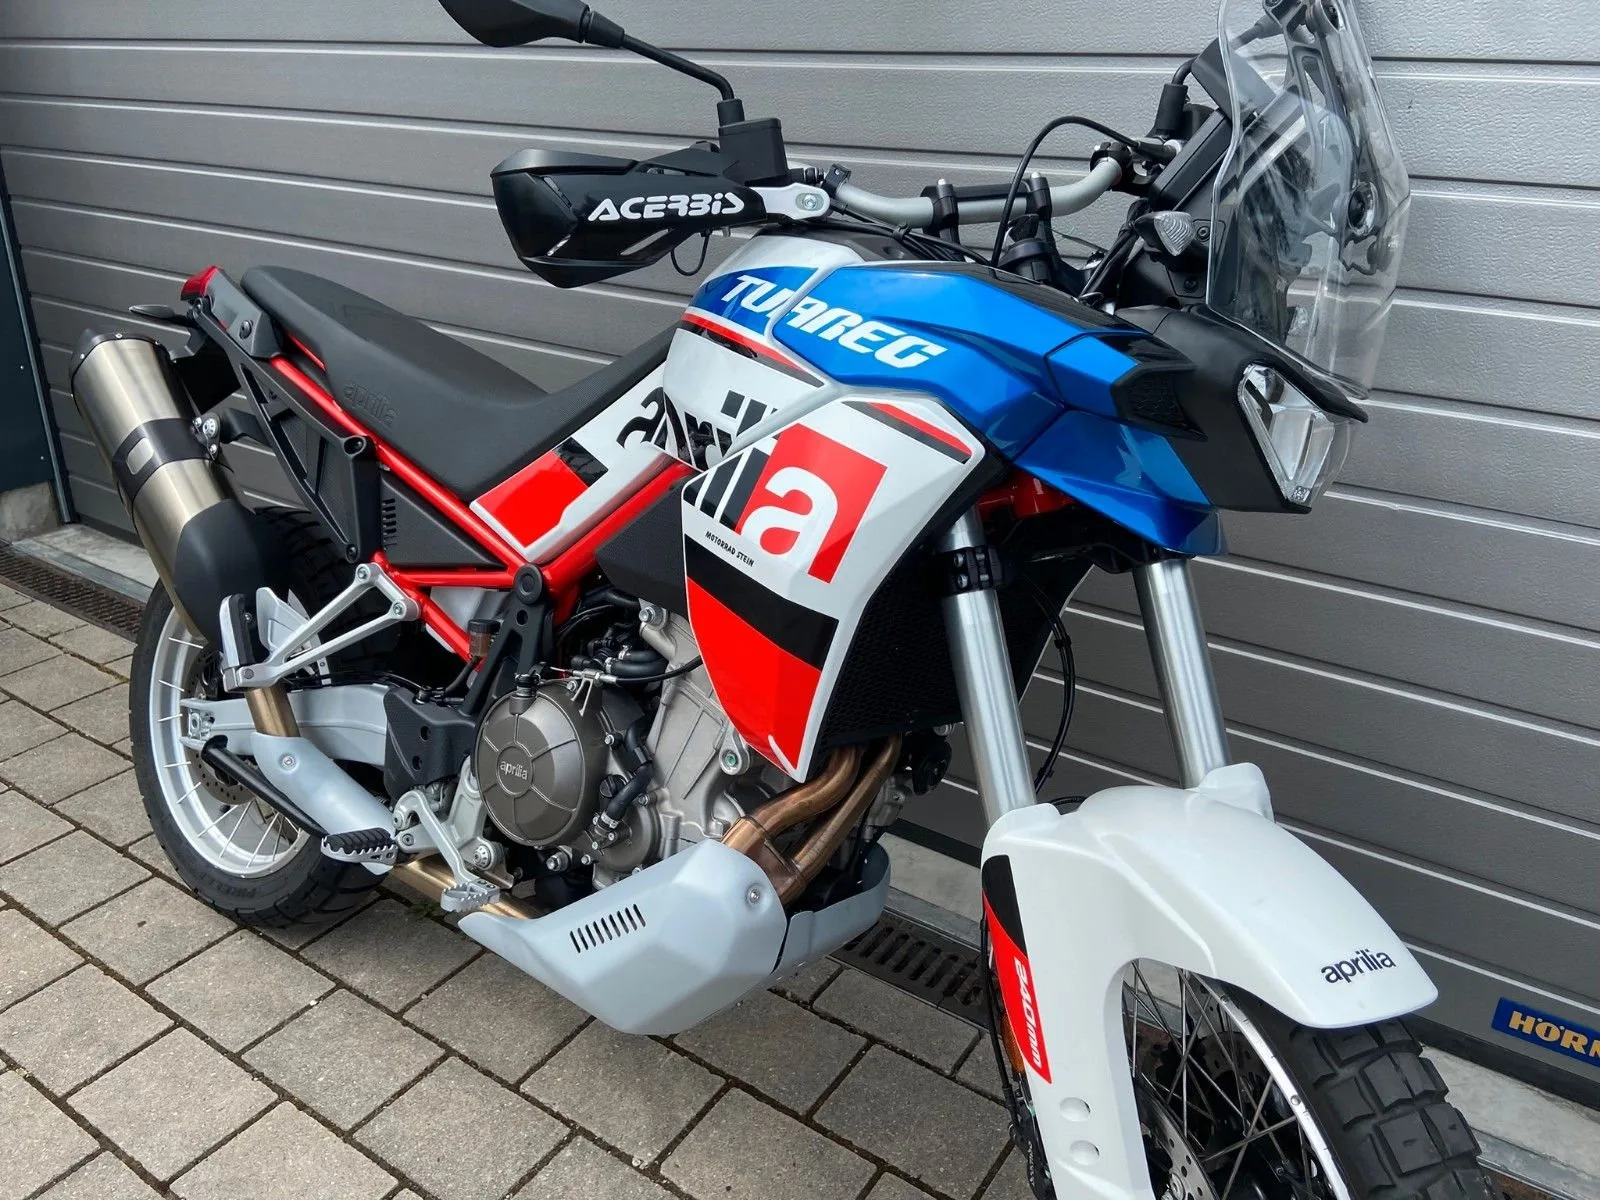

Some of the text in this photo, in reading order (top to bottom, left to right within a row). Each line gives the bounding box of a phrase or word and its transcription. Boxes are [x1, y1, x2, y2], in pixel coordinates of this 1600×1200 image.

[720, 274, 949, 369] TUAREG
[705, 530, 755, 567] MOTORRAD STEIN
[500, 761, 527, 780] aprilia
[1320, 948, 1397, 984] aprilia
[1014, 956, 1042, 1068] 240mm
